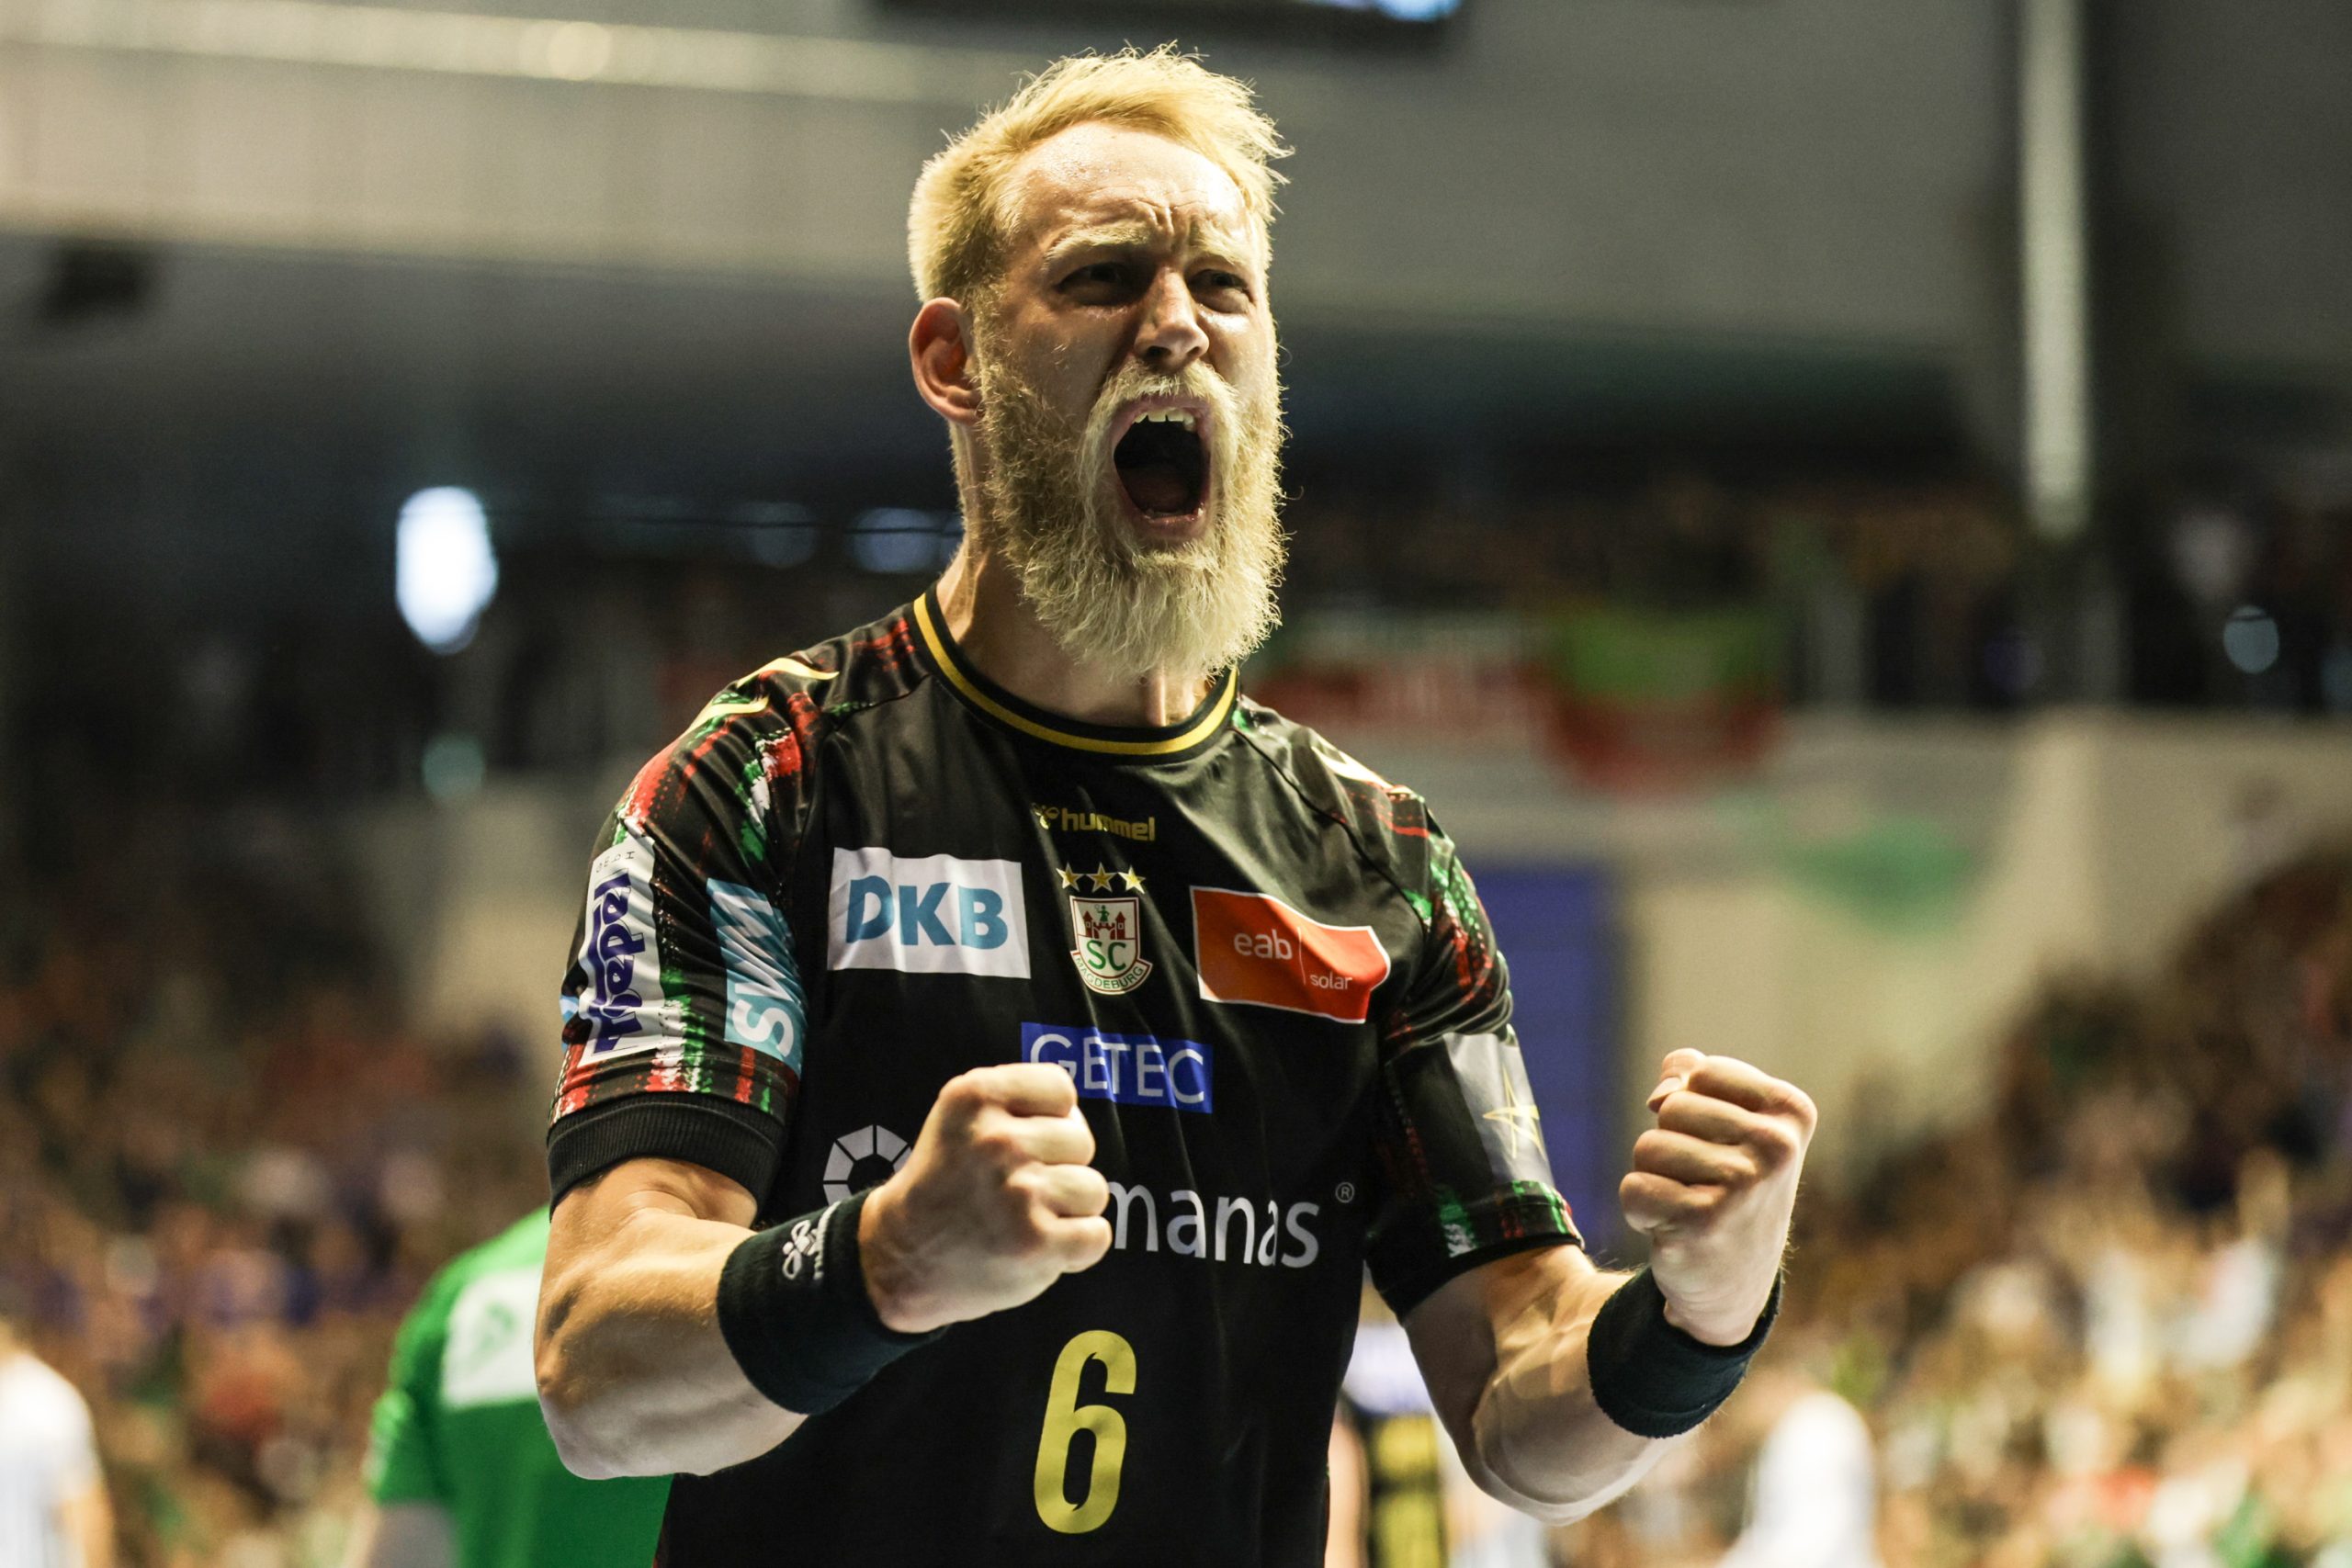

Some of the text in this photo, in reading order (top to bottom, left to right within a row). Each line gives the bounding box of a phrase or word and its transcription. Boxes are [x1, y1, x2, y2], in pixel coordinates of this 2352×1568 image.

[1061, 807, 1155, 841] hummel
[845, 874, 1008, 950] DKB
[1076, 957, 1145, 989] MAGDEBURG
[1086, 940, 1126, 971] SC
[1234, 929, 1352, 990] eab solar
[1030, 1033, 1204, 1104] GETEC
[1108, 1180, 1319, 1269] manas
[1034, 1330, 1136, 1534] 6
